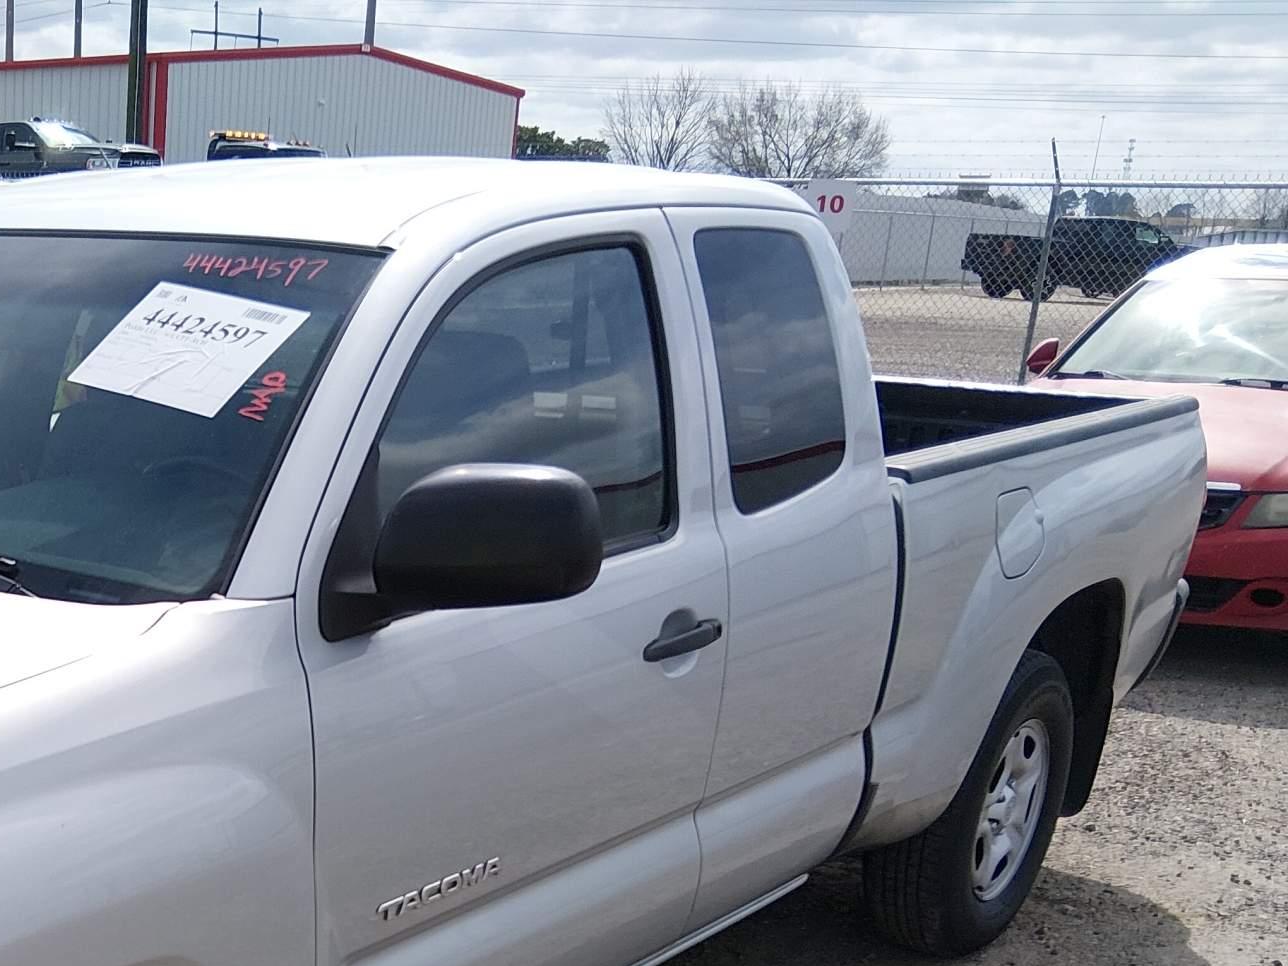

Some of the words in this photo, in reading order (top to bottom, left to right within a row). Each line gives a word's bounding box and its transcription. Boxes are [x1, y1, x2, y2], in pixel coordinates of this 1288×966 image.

[817, 194, 845, 214] 10
[183, 252, 329, 287] 44424597
[142, 307, 269, 349] 44424597
[376, 856, 502, 921] TACOMA
